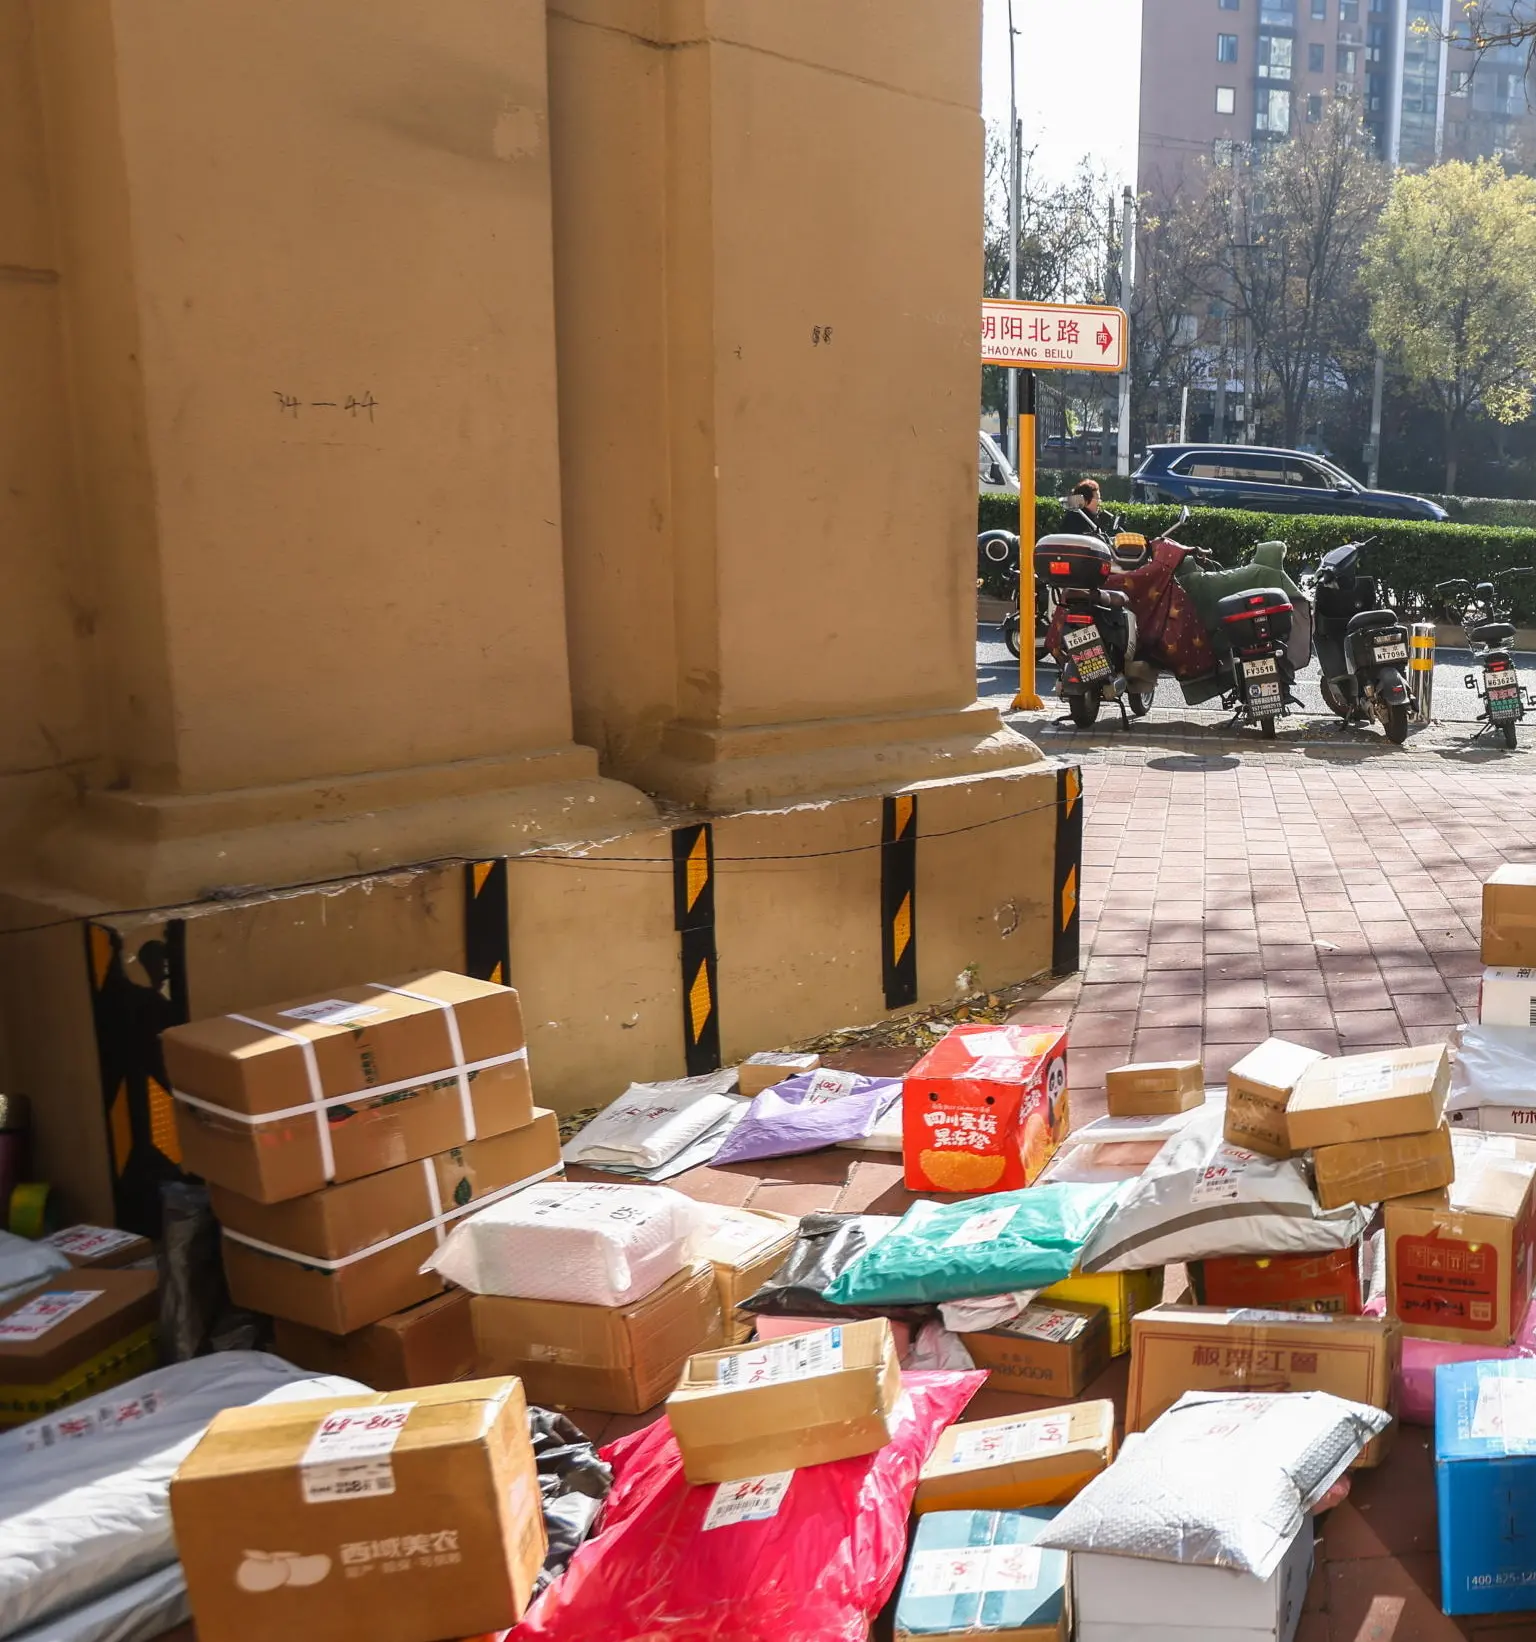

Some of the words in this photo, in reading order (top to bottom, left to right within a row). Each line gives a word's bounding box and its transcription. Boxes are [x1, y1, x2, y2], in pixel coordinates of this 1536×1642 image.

[981, 315, 1081, 345] 朝阳北路
[1097, 331, 1108, 346] 西
[1044, 347, 1074, 360] BEILU
[923, 1111, 998, 1134] 四川爱媛
[339, 1529, 460, 1566] 西域美农
